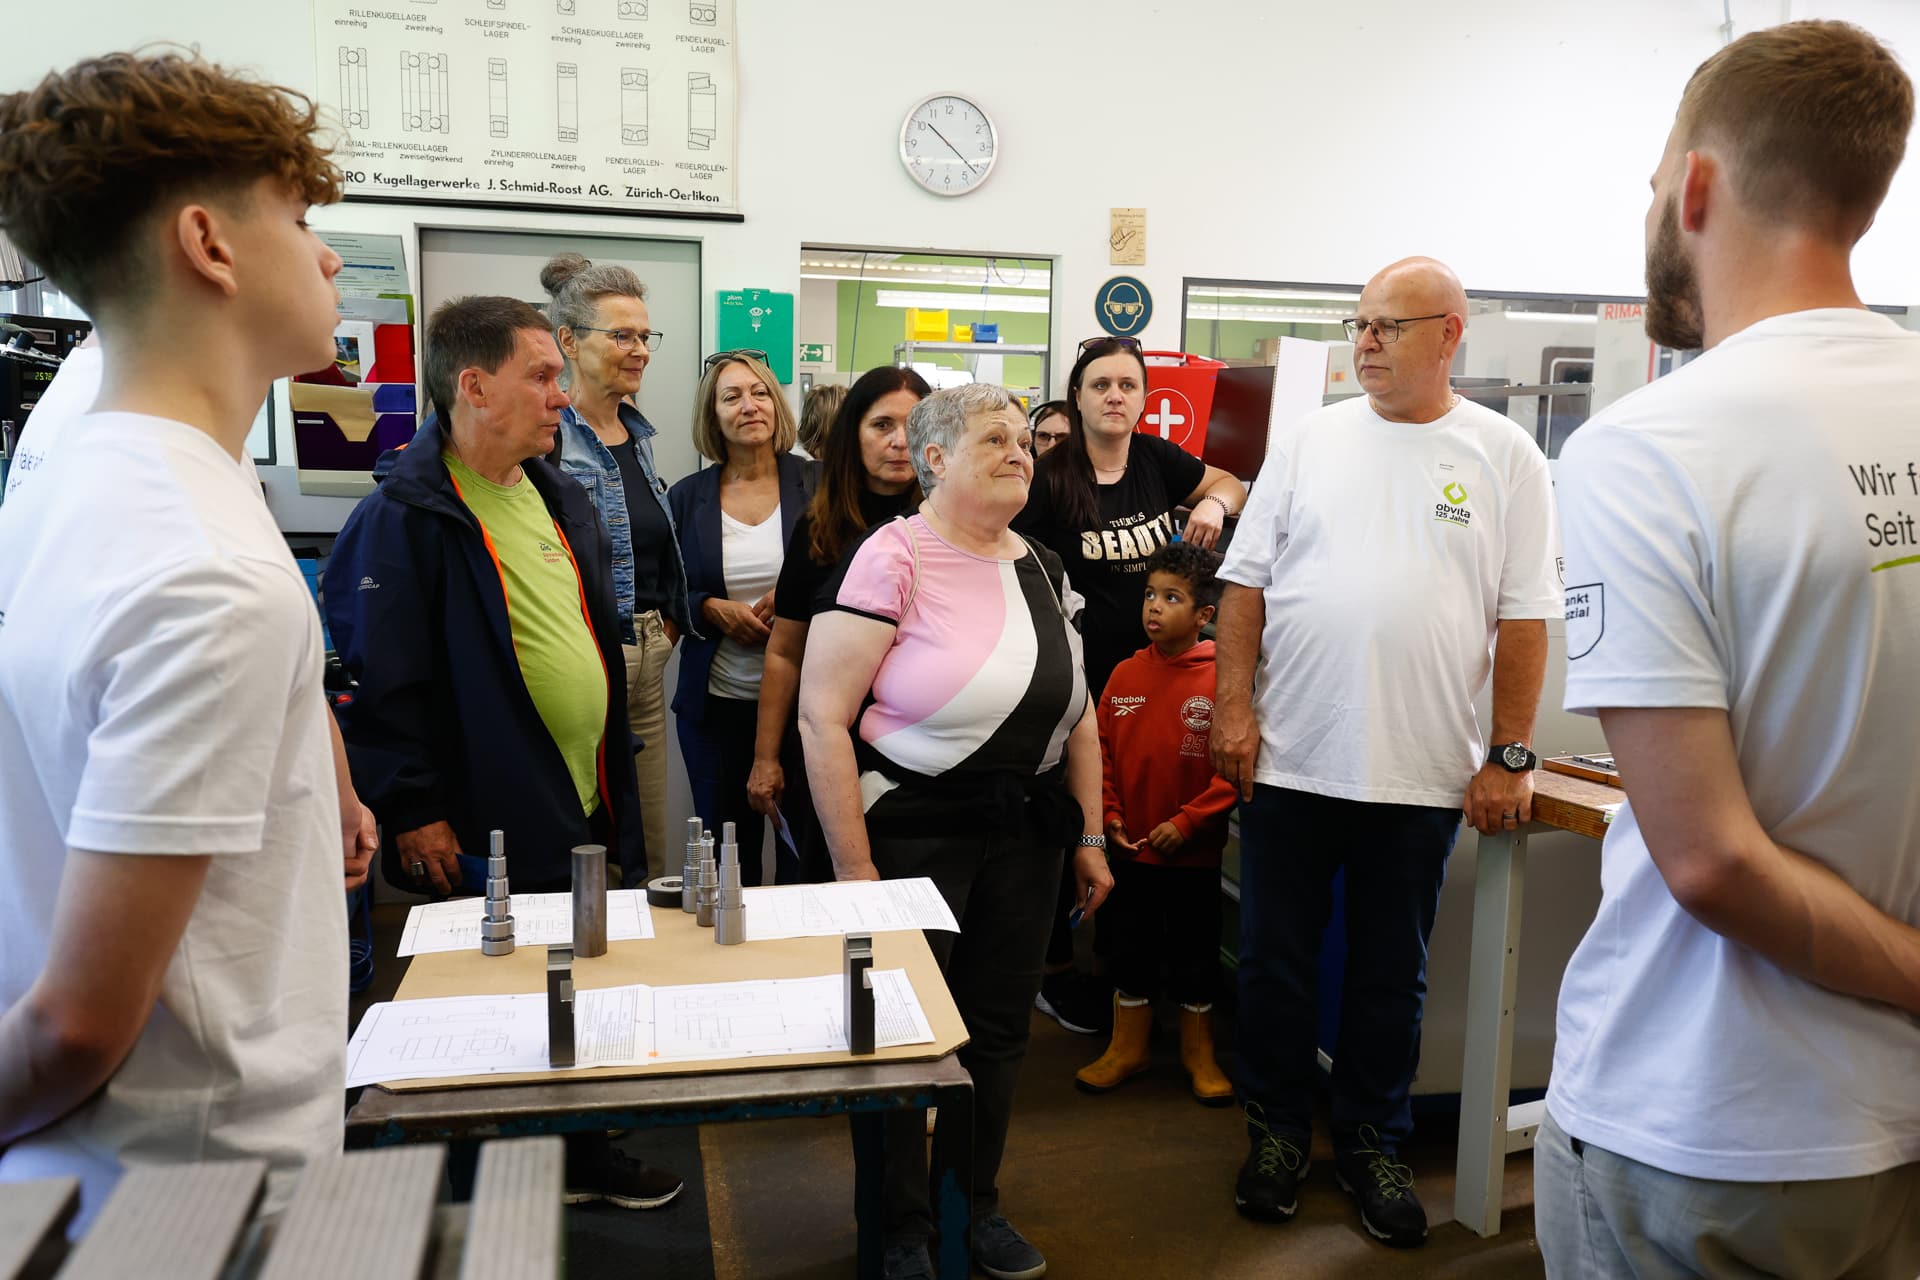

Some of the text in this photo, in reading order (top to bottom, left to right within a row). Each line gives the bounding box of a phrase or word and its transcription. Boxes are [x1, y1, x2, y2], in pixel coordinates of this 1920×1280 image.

[349, 9, 427, 22] RILLENKUGELLAGER
[334, 18, 368, 29] einreihig
[405, 24, 443, 34] zweireihig
[561, 26, 644, 40] SCHRAEGKUGELLAGER
[484, 30, 509, 39] LAGER
[551, 35, 582, 45] einreihig
[675, 34, 730, 47] PENDELKUGEL-
[615, 41, 651, 51] zweireihig
[691, 45, 716, 54] LAGER
[930, 109, 937, 119] 11
[945, 104, 954, 115] 12
[917, 121, 927, 131] 10
[975, 124, 982, 134] 2
[911, 139, 917, 148] 9
[979, 143, 986, 151] 3
[400, 153, 463, 164] zweiseitigwirkend
[490, 149, 577, 162] ZYLINDERROLLENLAGER
[484, 159, 514, 168] einreihig
[551, 163, 586, 172] zweireihig
[605, 157, 664, 168] PENDELROLLEN-
[675, 162, 728, 173] KEGELROLLEN-
[623, 167, 646, 175] LAGER
[690, 172, 713, 180] LAGER
[928, 169, 934, 178] 7
[962, 171, 968, 181] 5
[944, 175, 950, 184] 6
[374, 173, 480, 189] Kugellagerwerke
[488, 178, 496, 190] J.
[500, 179, 582, 195] Schmid-Roost
[588, 184, 613, 196] AG.
[625, 186, 720, 203] Zürich-Oerlikon
[1848, 462, 1920, 496] Wir f
[1436, 503, 1471, 519] obvita
[1435, 510, 1469, 525] 125 Jahre
[1865, 511, 1918, 547] Seit
[1080, 511, 1174, 560] BEAUTY
[1111, 695, 1146, 705] Reebok
[1181, 733, 1207, 752] 95
